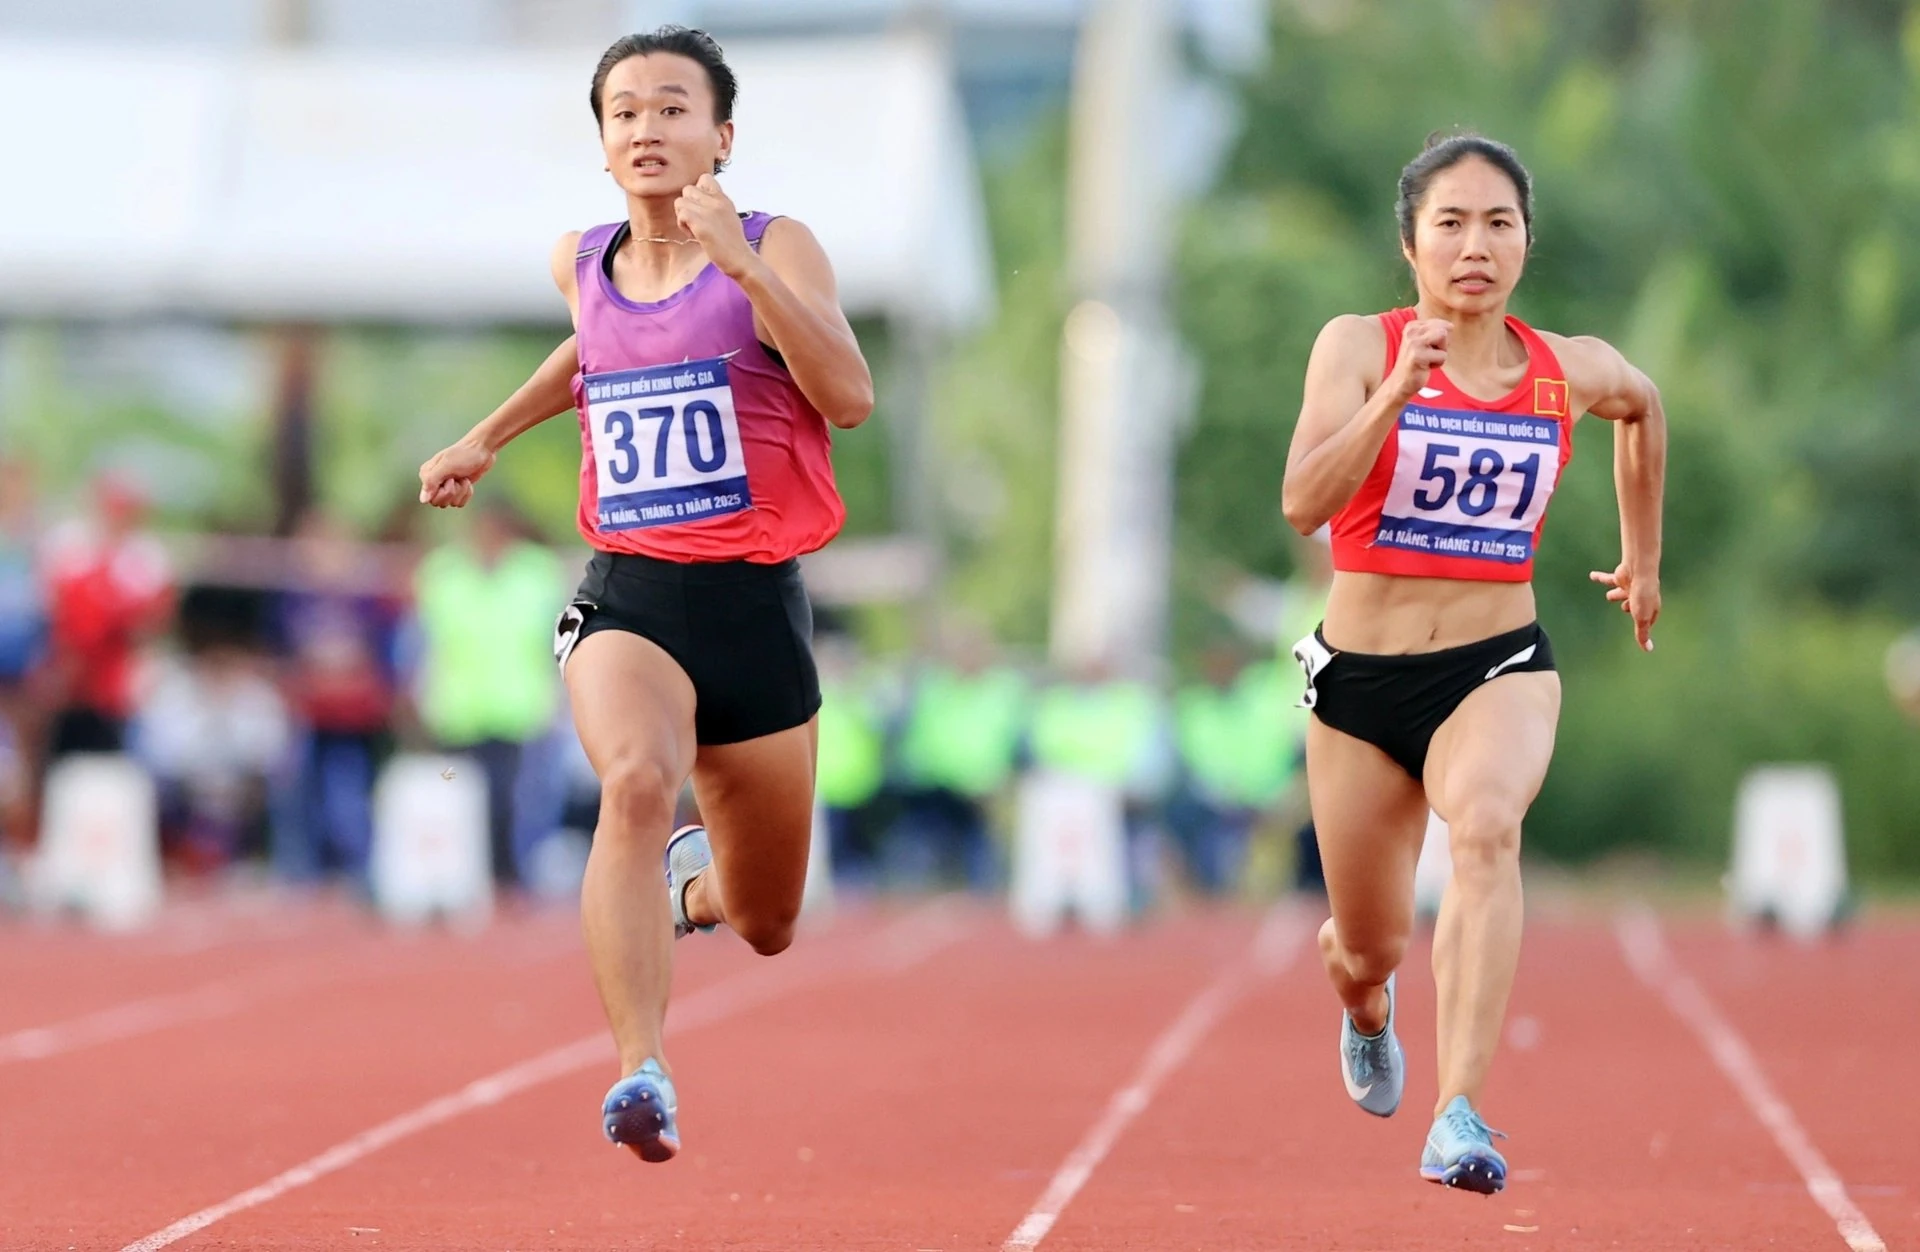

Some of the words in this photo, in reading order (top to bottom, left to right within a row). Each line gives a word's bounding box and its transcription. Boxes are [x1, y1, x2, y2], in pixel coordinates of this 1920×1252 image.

[651, 376, 673, 391] KINH
[673, 369, 697, 390] QUỐC
[698, 371, 715, 385] GIA
[1404, 409, 1425, 426] GIẢI
[1440, 416, 1462, 432] ĐỊCH
[1485, 421, 1507, 436] KINH
[1508, 420, 1534, 438] QUỐC
[1535, 426, 1550, 440] GIA
[604, 399, 727, 484] 370
[1413, 443, 1540, 520] 581
[640, 503, 675, 521] THÁNG
[675, 504, 684, 516] 8
[686, 496, 712, 515] NĂM
[714, 493, 742, 508] 2025
[1471, 539, 1479, 553] 8
[1505, 543, 1526, 559] 2025
